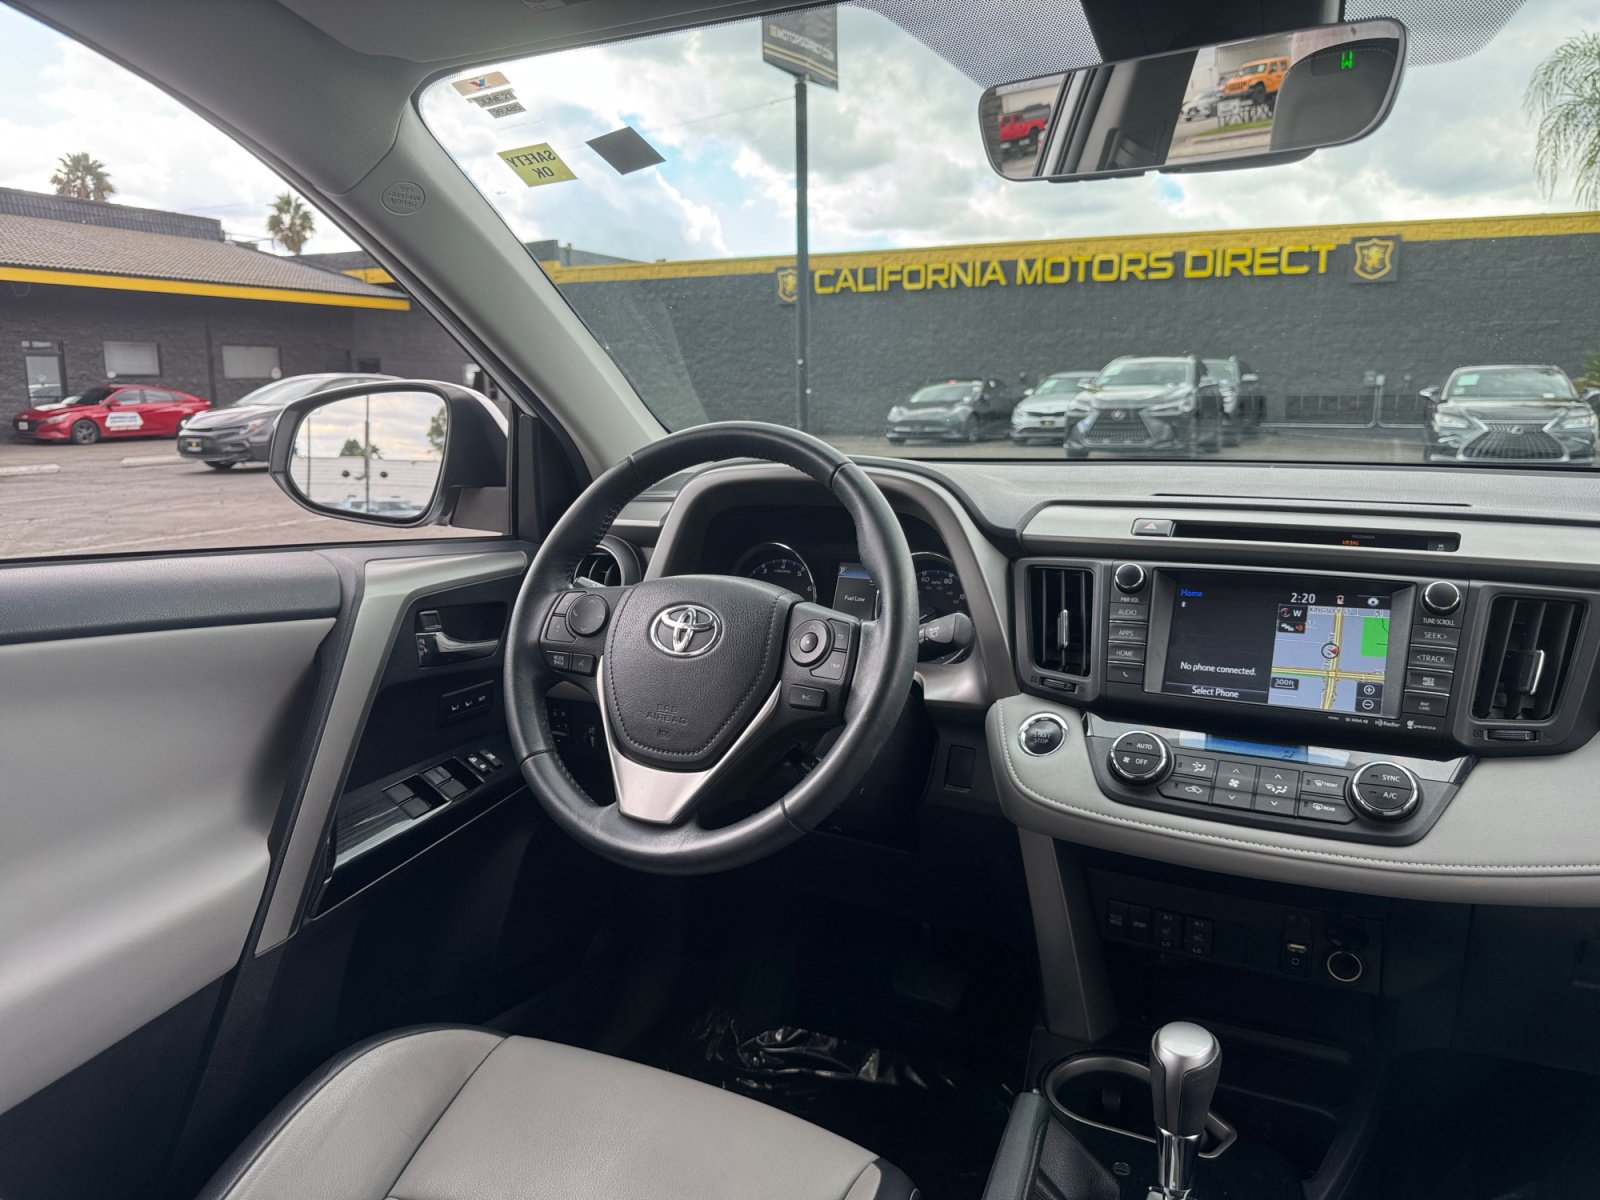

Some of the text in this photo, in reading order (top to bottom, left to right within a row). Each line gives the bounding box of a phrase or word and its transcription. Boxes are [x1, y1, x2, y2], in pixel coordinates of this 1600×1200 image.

[1341, 51, 1353, 69] W
[480, 95, 501, 106] JUNE
[814, 243, 1337, 295] CALIFORNIA MOTORS DIRECT
[1181, 588, 1203, 597] Home
[1290, 592, 1316, 604] 2:20
[1293, 609, 1302, 617] W
[1118, 629, 1134, 637] APPS
[1116, 650, 1134, 658] HOME
[1180, 661, 1257, 676] No phone connected.
[1192, 685, 1240, 699] Select Phone
[1136, 742, 1153, 750] AUTO
[1135, 758, 1149, 766] OFF
[1382, 774, 1400, 783] SYNC
[1382, 791, 1397, 800] A/C
